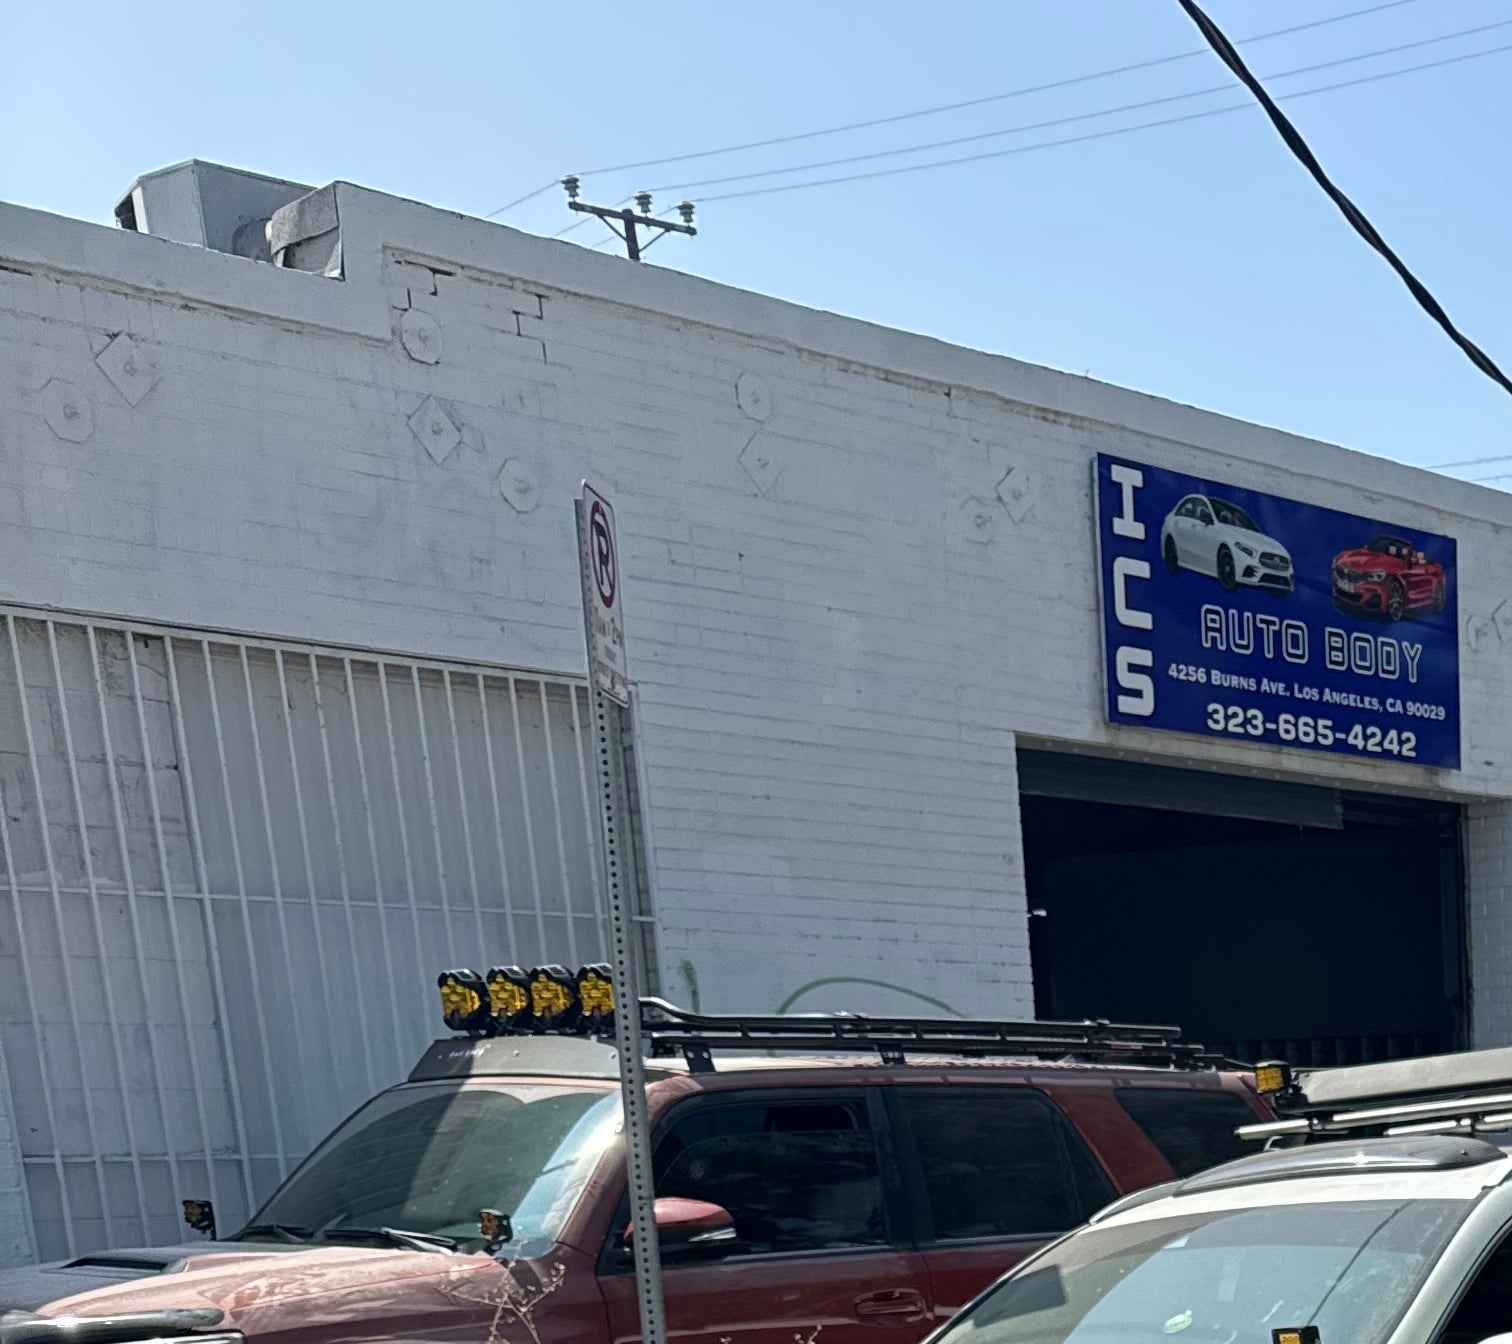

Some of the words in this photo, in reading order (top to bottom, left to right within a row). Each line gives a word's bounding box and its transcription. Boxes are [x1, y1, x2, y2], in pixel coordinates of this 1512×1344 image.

[1201, 604, 1309, 664] AUTO
[1324, 626, 1423, 683] BODY
[1168, 663, 1207, 684] 4256
[1386, 698, 1404, 715] CA
[1406, 701, 1446, 721] 90029
[1206, 703, 1418, 758] 323-665-4242
